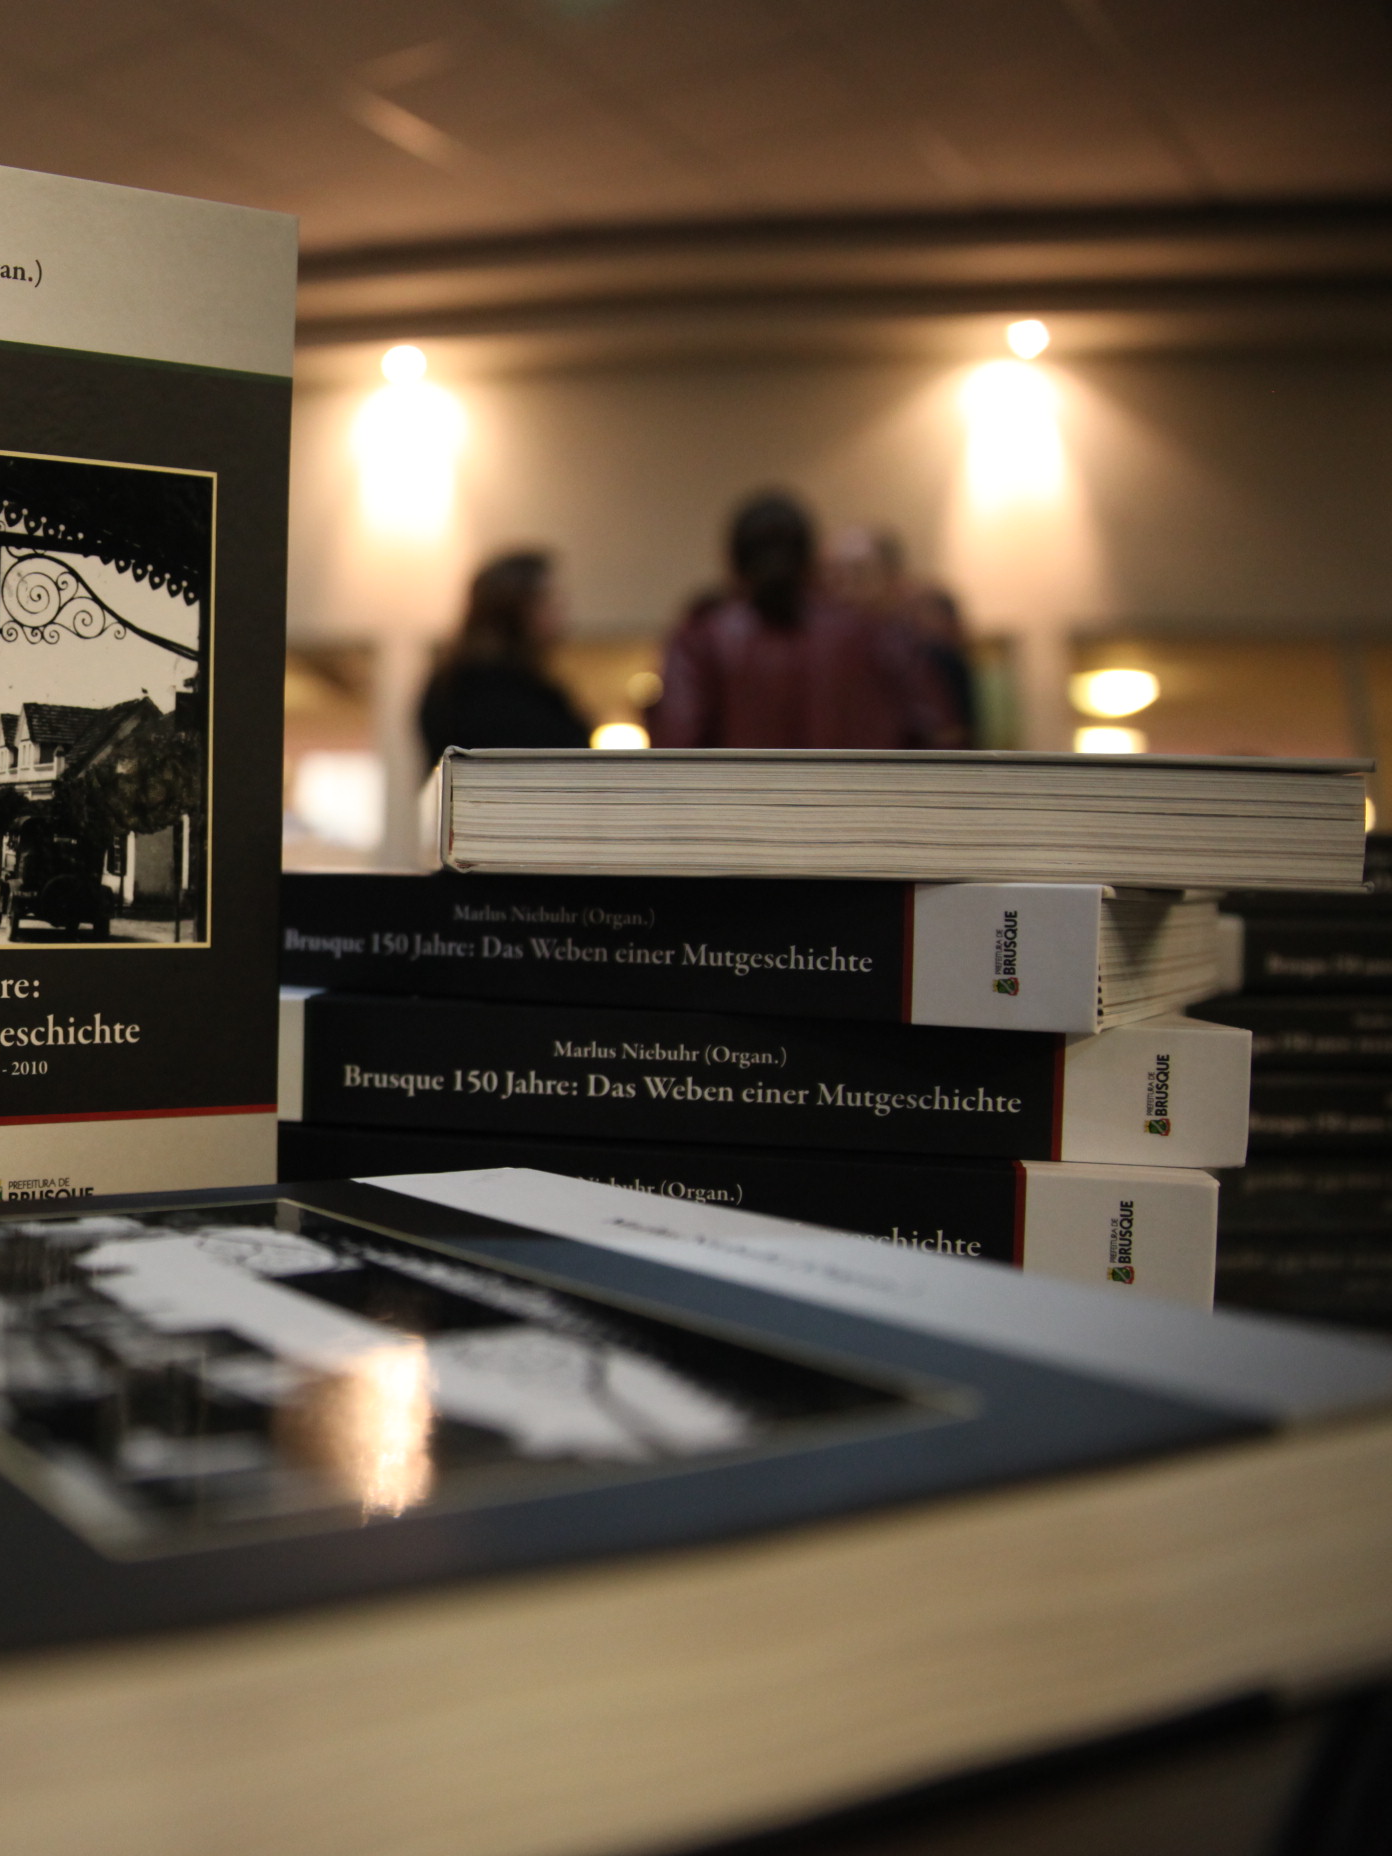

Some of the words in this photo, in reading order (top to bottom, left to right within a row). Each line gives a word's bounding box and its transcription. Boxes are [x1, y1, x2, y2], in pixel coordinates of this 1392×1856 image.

[582, 907, 655, 930] (Organ.)
[283, 927, 365, 959] Brusque
[372, 932, 408, 955] 150
[410, 933, 475, 962] Jahre:
[482, 935, 524, 960] Das
[530, 936, 607, 962] Weben
[615, 942, 675, 965] einer
[682, 943, 873, 976] Mutgeschichte
[1003, 911, 1017, 975] BRUSQUE
[11, 1060, 48, 1076] 2010
[554, 1040, 616, 1059] Marlus
[622, 1041, 699, 1061] Niebuhr
[705, 1044, 787, 1069] (Organ.)
[343, 1064, 444, 1097] Brusque
[453, 1070, 498, 1093] 150
[500, 1070, 578, 1099] Jahre:
[587, 1073, 636, 1098] Das
[643, 1076, 734, 1102] Weben
[741, 1082, 809, 1105] einer
[816, 1082, 1022, 1117] Mutgeschichte
[1155, 1054, 1170, 1116] BRUSQUE
[8, 1178, 56, 1190] PREFEITURA
[58, 1178, 70, 1187] DE
[660, 1179, 743, 1206] (Organ.)
[1118, 1201, 1134, 1264] BRUSQUE
